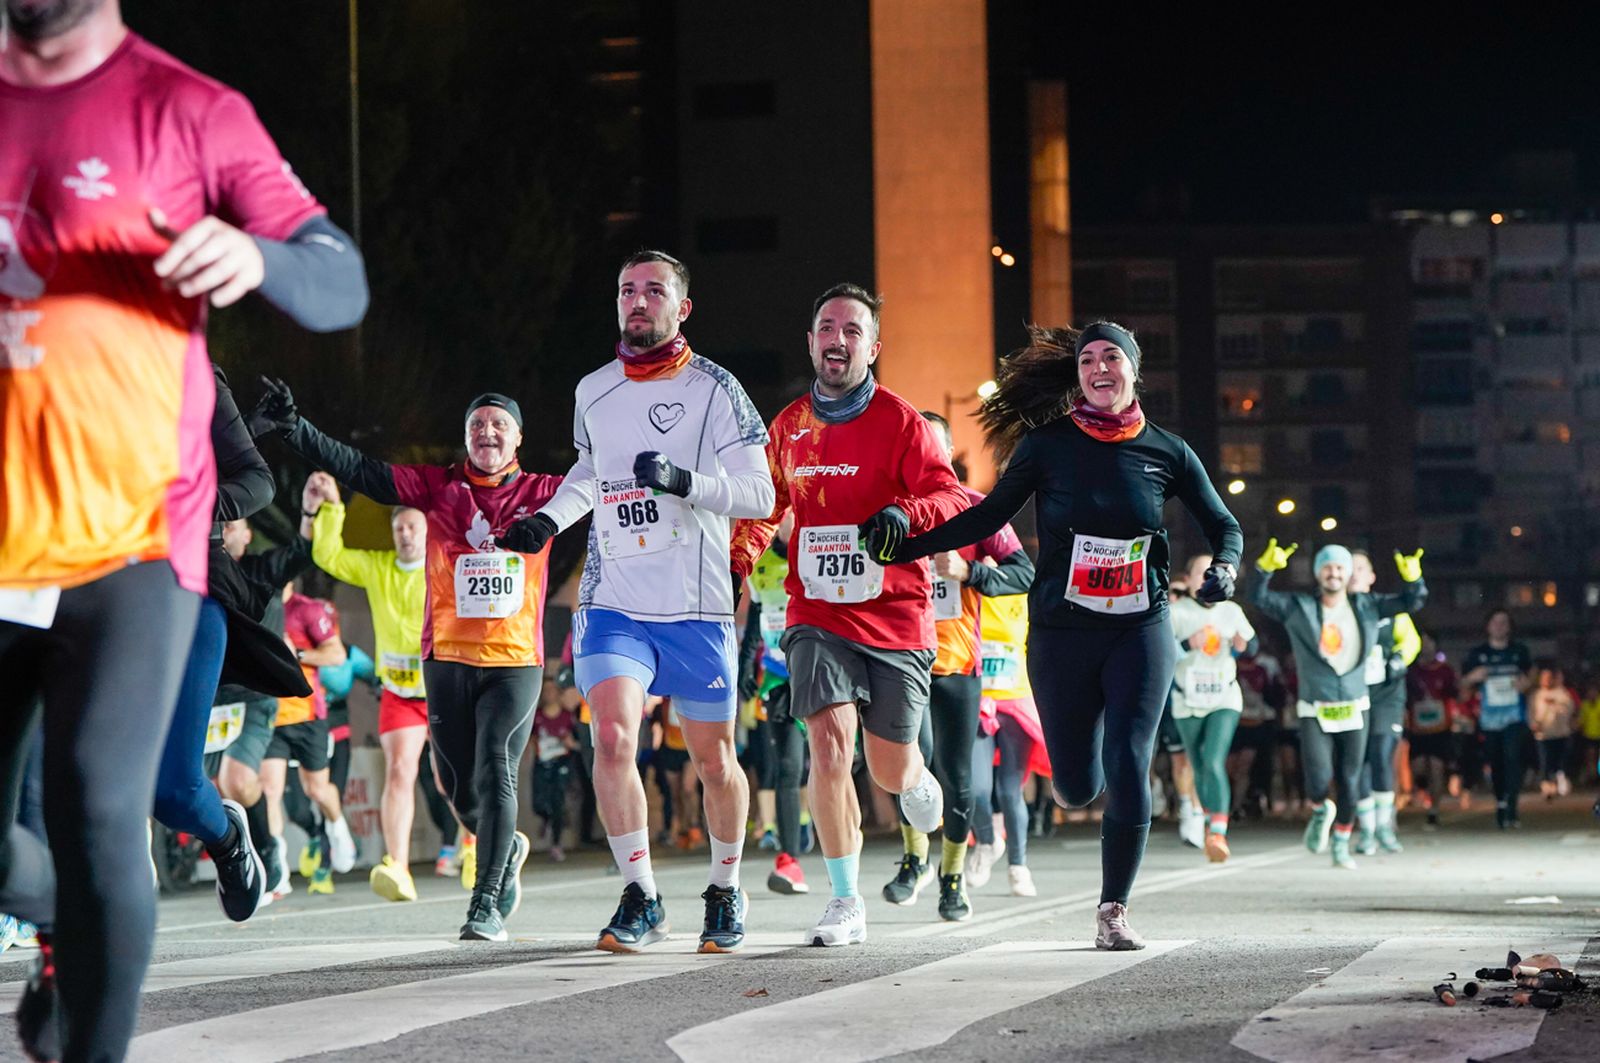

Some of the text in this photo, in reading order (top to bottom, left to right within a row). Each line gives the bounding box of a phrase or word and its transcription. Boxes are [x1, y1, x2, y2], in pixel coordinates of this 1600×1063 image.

[794, 464, 859, 477] ESPAÑA
[611, 482, 633, 492] NOCHE
[603, 494, 619, 504] SAN
[617, 499, 660, 528] 968
[816, 534, 839, 543] NOCHE
[840, 534, 850, 542] DE
[808, 542, 851, 553] SAN ANTÓN
[816, 553, 865, 577] 7376
[1082, 555, 1099, 565] SAN
[463, 568, 477, 577] SAN
[1087, 563, 1134, 590] 9674
[468, 576, 513, 596] 2390
